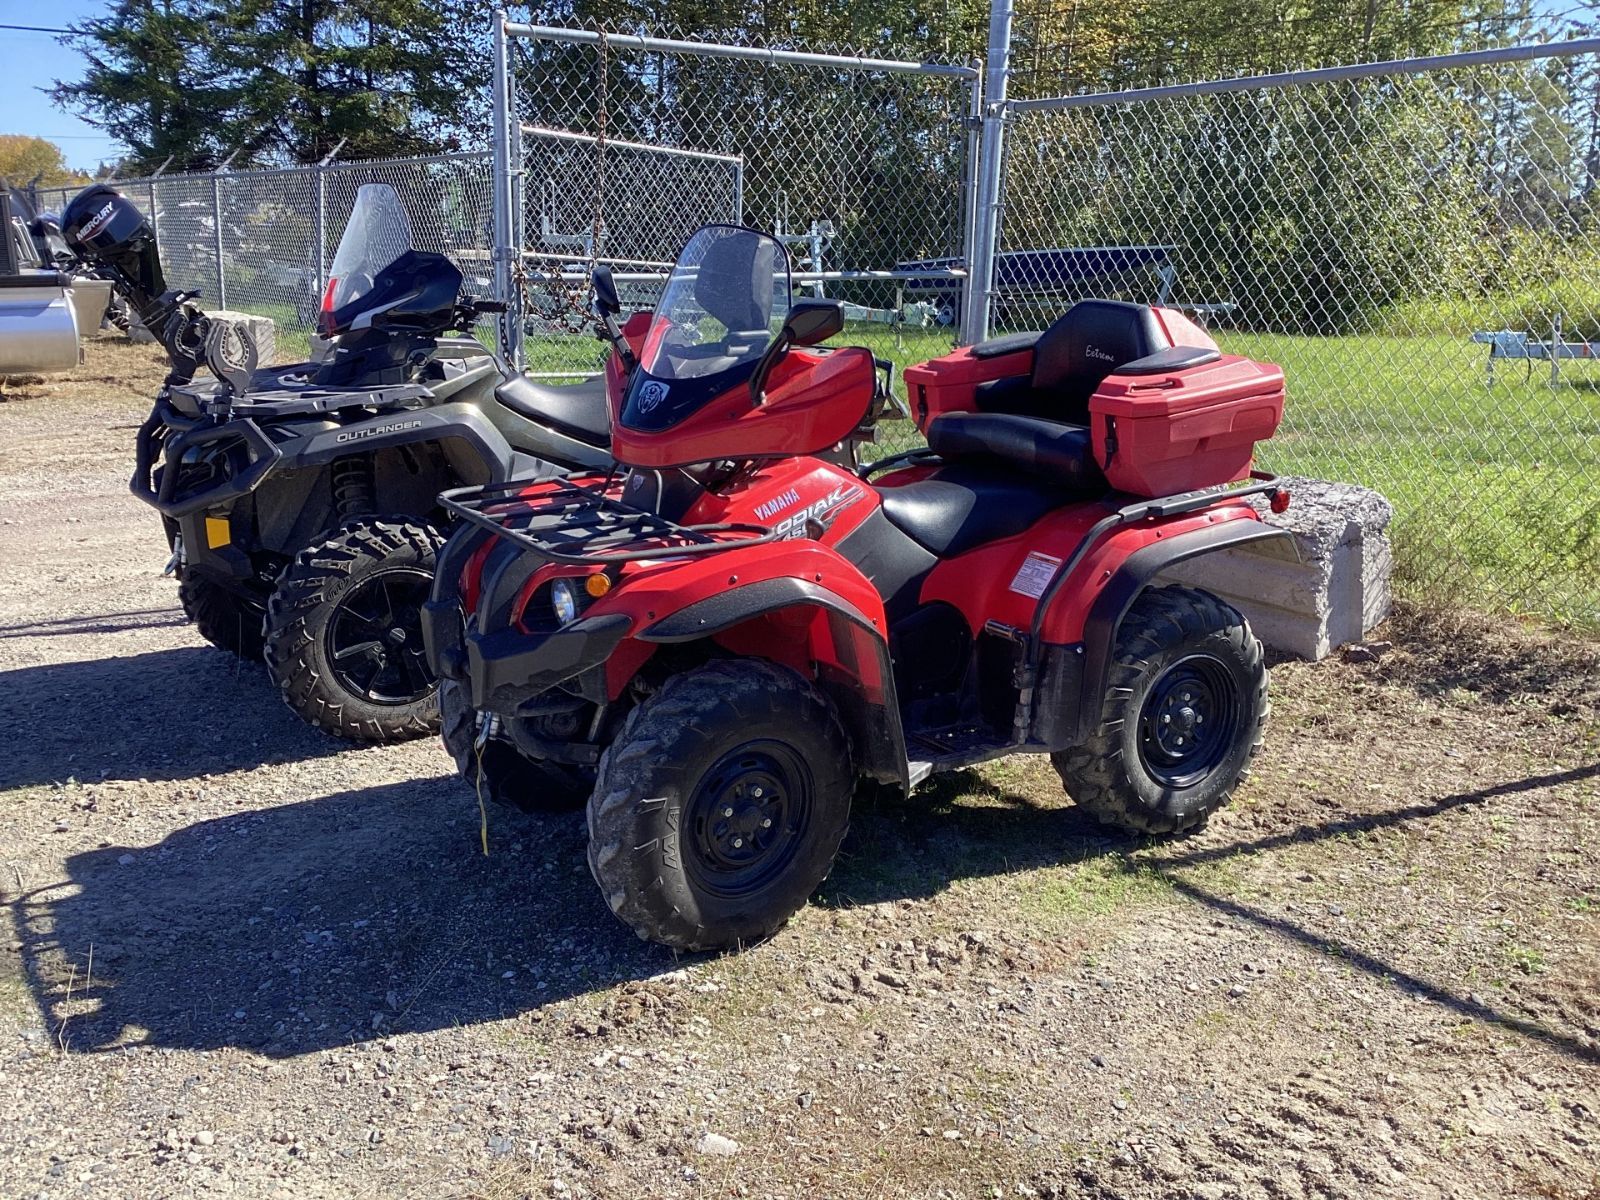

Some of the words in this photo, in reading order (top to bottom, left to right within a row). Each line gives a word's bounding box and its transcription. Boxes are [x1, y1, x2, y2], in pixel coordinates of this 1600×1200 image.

[75, 201, 114, 241] MERCURY
[1085, 344, 1115, 362] Extreme
[336, 420, 422, 442] OUTLANDER
[753, 487, 801, 521] YAMAHA
[775, 484, 846, 535] ODIAK
